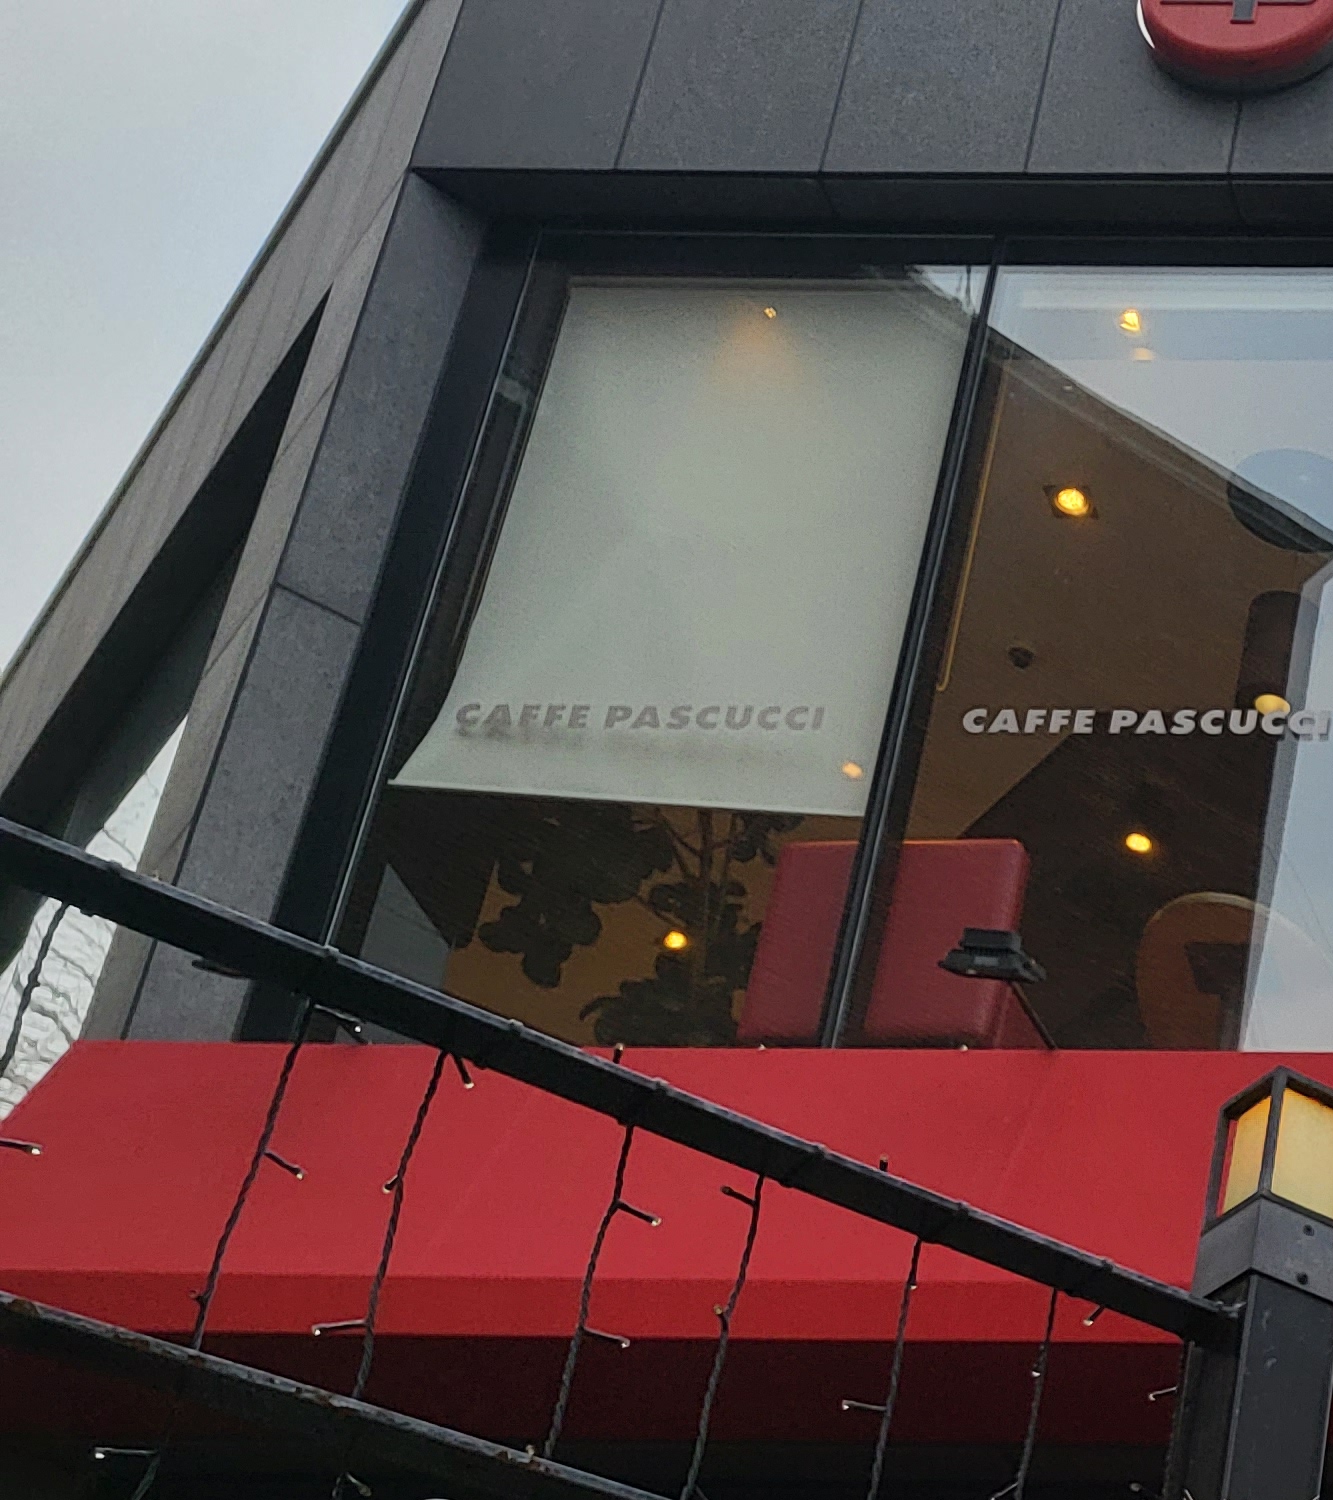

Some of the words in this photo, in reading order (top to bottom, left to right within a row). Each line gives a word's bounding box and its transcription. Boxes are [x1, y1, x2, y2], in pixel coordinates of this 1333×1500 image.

[456, 703, 590, 730] CAFFE
[604, 705, 825, 731] PASCUCCI
[962, 708, 1096, 735] CAFFE
[1109, 709, 1331, 740] PASCUCCI
